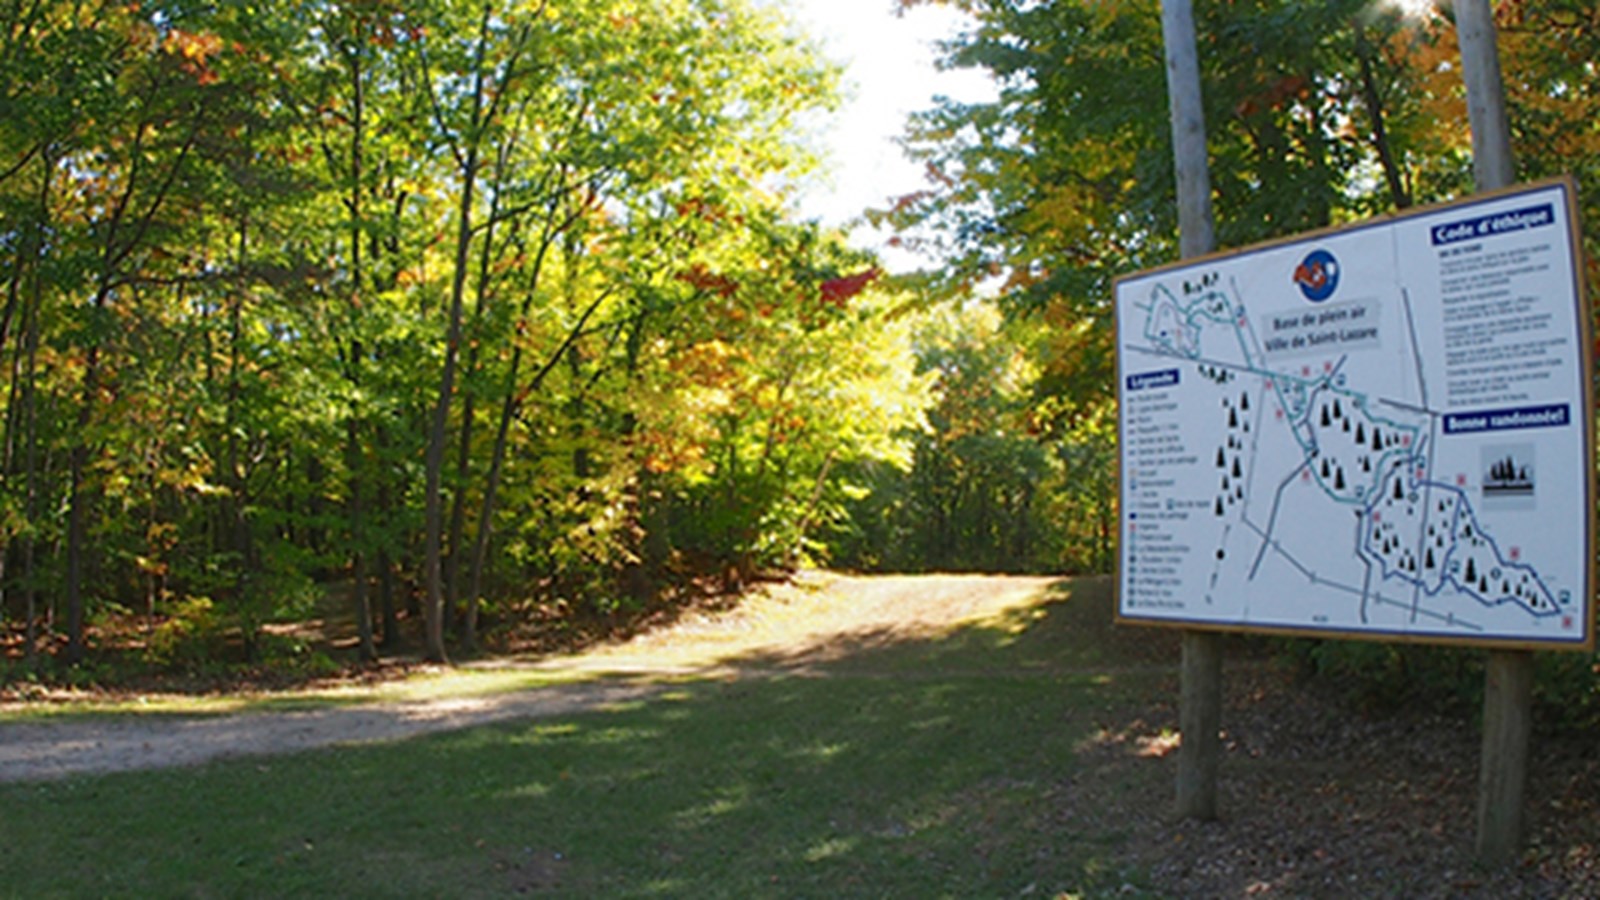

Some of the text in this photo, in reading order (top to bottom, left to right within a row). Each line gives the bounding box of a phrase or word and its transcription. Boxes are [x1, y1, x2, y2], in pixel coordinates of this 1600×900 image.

[1436, 223, 1474, 242] Code
[1273, 307, 1366, 331] Base de plein air
[1265, 327, 1378, 352] Ville de Saint-Lazare
[1448, 414, 1487, 430] Bonne
